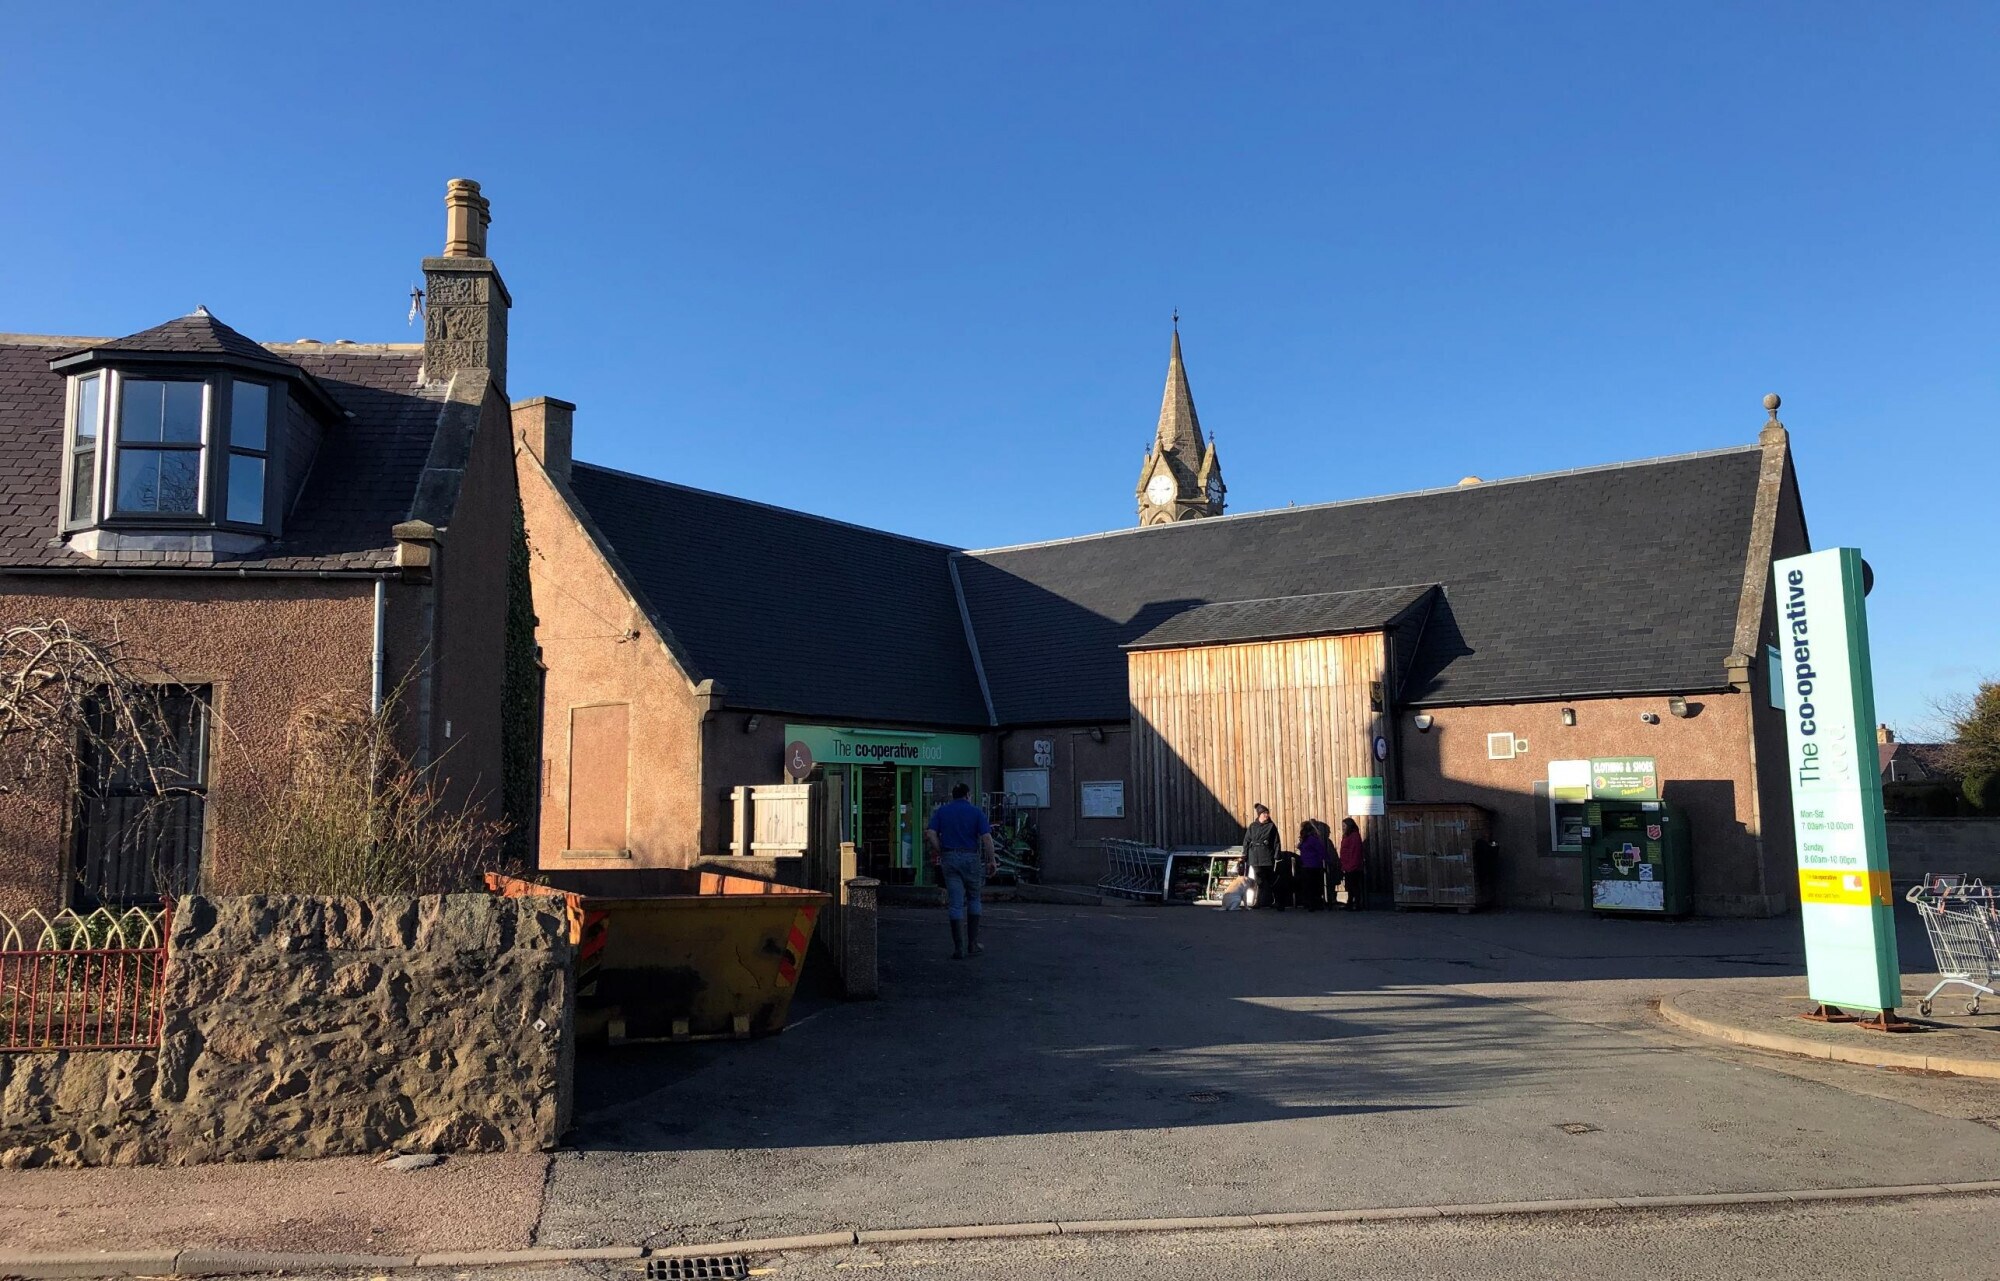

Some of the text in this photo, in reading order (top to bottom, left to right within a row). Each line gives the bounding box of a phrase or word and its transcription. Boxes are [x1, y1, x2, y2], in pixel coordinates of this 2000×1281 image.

[1785, 569, 1820, 787] The co-operative
[833, 739, 942, 760] The co-operative food
[1593, 761, 1653, 773] CLOTHING & SHOES
[1800, 810, 1824, 818] Mon-Sat
[1803, 843, 1824, 853] Sunday
